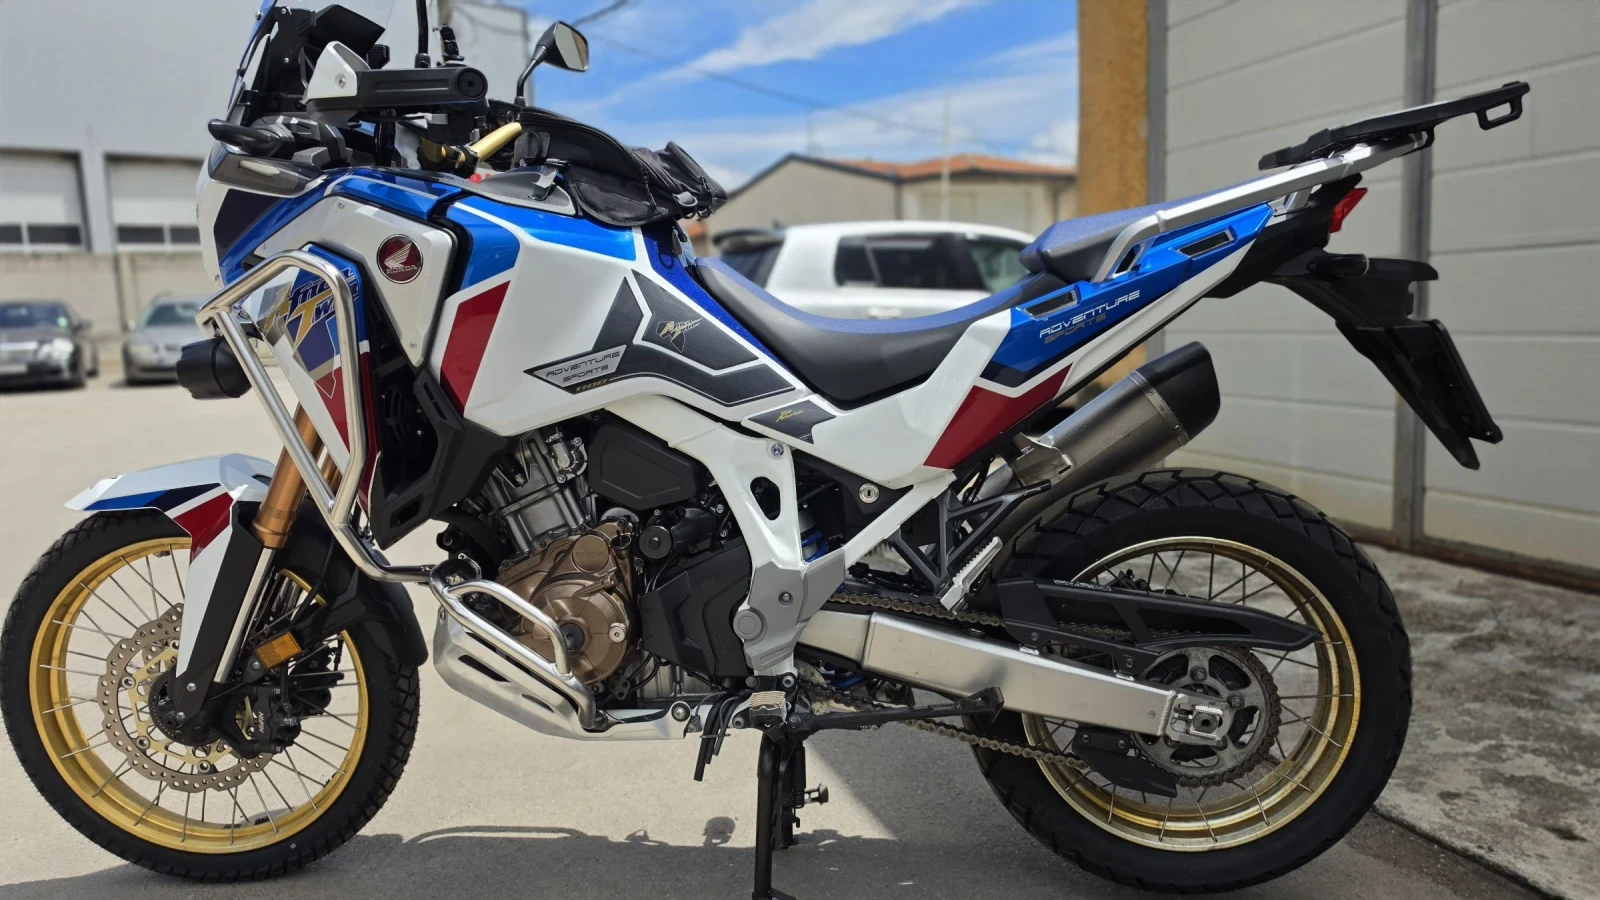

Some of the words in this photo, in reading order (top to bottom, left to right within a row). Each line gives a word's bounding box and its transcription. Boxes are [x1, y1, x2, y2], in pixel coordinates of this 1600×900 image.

[386, 264, 418, 274] HONDA
[1039, 290, 1140, 338] ADVENTURE
[1044, 313, 1106, 344] SPORTS
[545, 351, 621, 378] ADVENTURE
[562, 364, 609, 382] SPORTS
